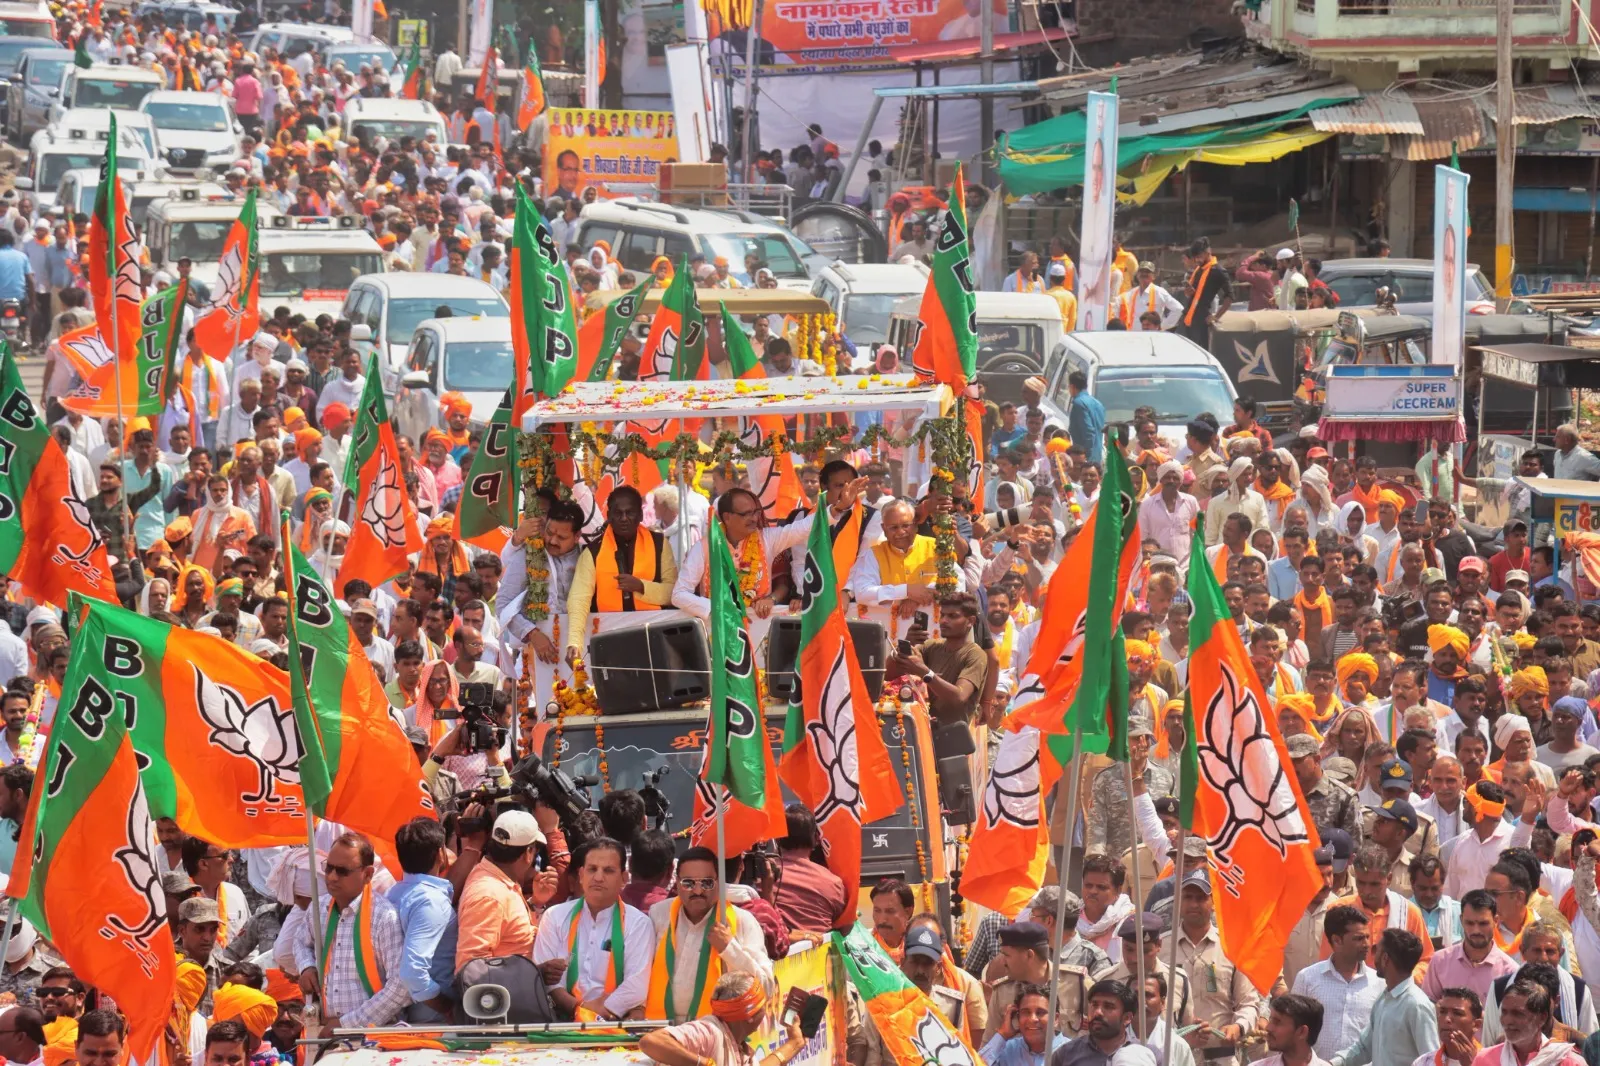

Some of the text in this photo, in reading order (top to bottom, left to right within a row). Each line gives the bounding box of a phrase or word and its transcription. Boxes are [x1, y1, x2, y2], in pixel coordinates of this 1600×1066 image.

[807, 17, 909, 39] में पधारे सभी बंधुओं का
[643, 155, 660, 175] चौहा
[534, 222, 574, 366] BJP
[1406, 382, 1447, 394] SUPER
[1392, 397, 1456, 410] ICECREAM
